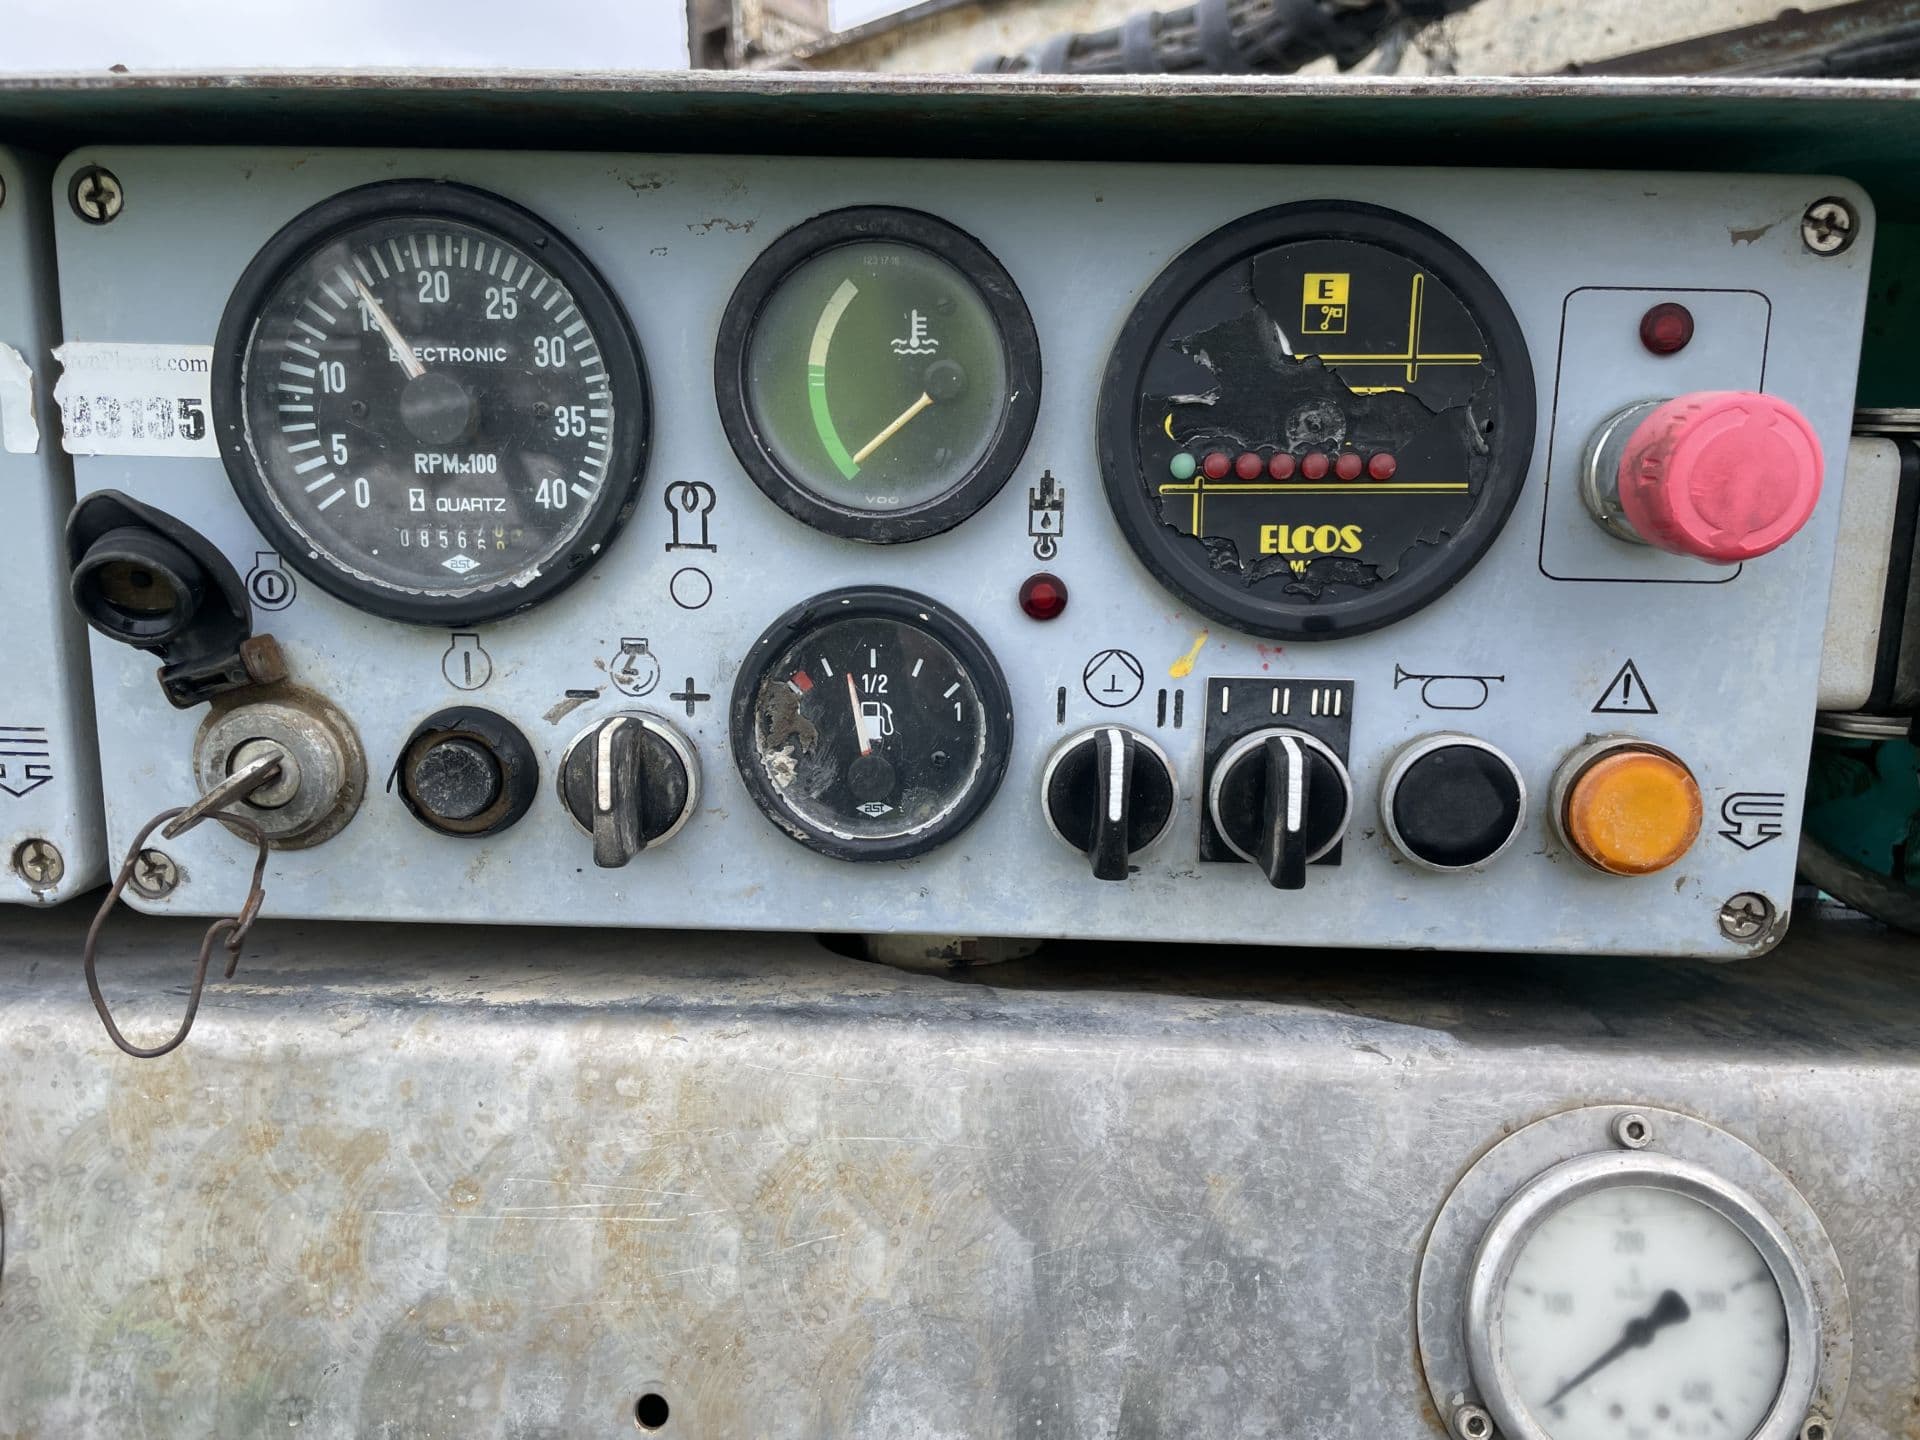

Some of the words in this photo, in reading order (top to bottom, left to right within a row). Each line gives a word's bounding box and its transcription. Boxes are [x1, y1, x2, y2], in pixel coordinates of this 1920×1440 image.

[418, 271, 450, 304] 20
[486, 288, 518, 320] 25
[388, 346, 508, 362] EECTRONIC
[534, 336, 566, 368] 30
[319, 361, 346, 394] 10
[555, 406, 586, 437] 35
[331, 434, 348, 466] 5
[414, 453, 498, 475] RPMx100
[355, 478, 371, 509] 0
[436, 497, 507, 513] QUARTZ
[535, 478, 568, 510] 40
[1260, 524, 1362, 554] ELCOS
[861, 673, 888, 694] 1/2
[954, 701, 962, 722] 1
